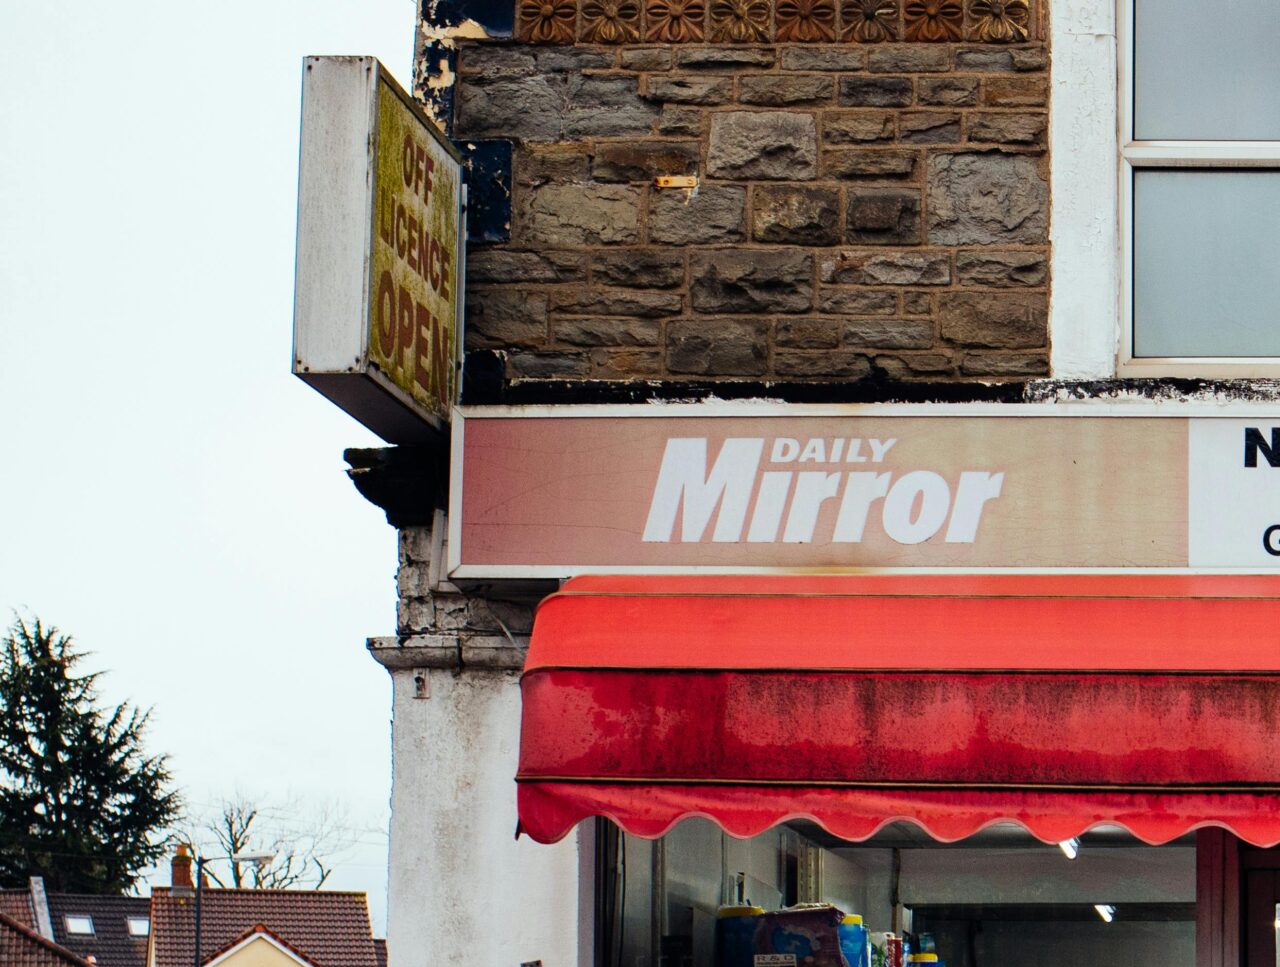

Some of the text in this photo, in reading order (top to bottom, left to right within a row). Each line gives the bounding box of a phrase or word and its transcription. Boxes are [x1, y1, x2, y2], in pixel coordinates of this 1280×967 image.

[402, 135, 435, 213] OFF
[379, 191, 451, 303] LICENCE
[377, 270, 451, 404] OPEN
[642, 437, 1004, 545] Mirror
[771, 437, 897, 463] DAILY
